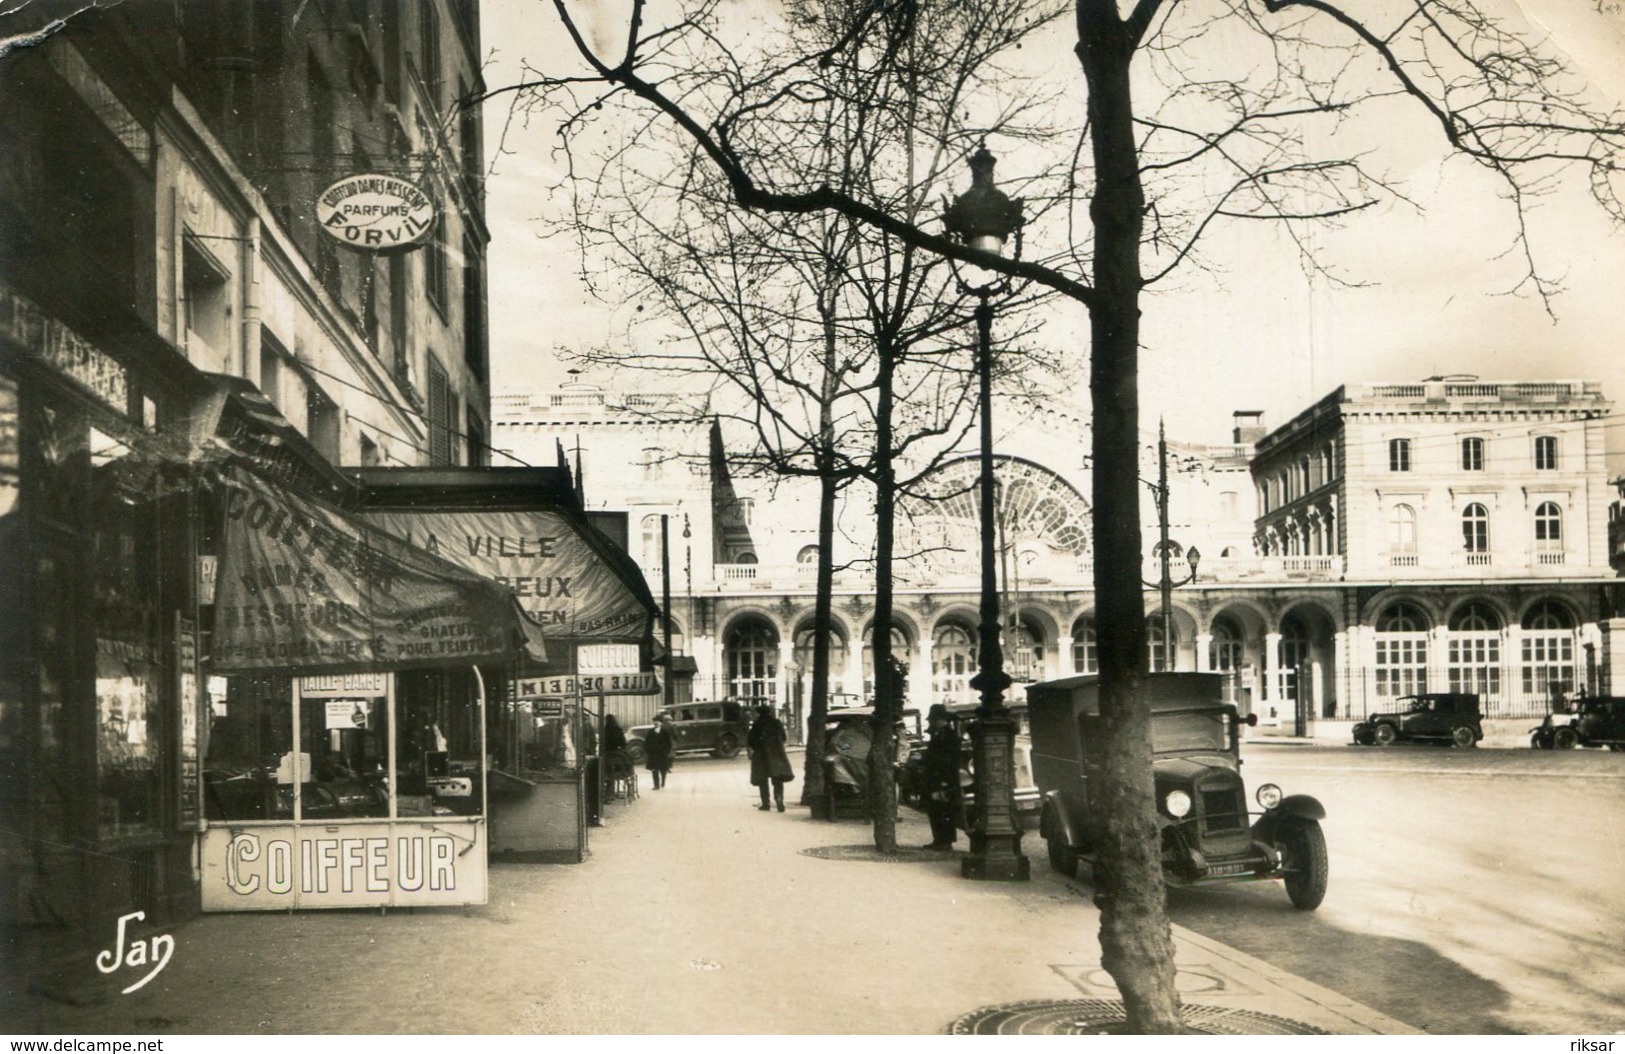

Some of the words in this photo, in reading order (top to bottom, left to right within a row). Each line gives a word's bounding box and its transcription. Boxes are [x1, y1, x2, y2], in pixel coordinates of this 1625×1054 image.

[358, 178, 386, 196] DAMES
[343, 204, 409, 217] PARFUMS
[467, 535, 557, 559] VILLE
[397, 641, 434, 656] POUR
[578, 645, 640, 669] COIFFEUR
[226, 833, 456, 896] COIFFEUR
